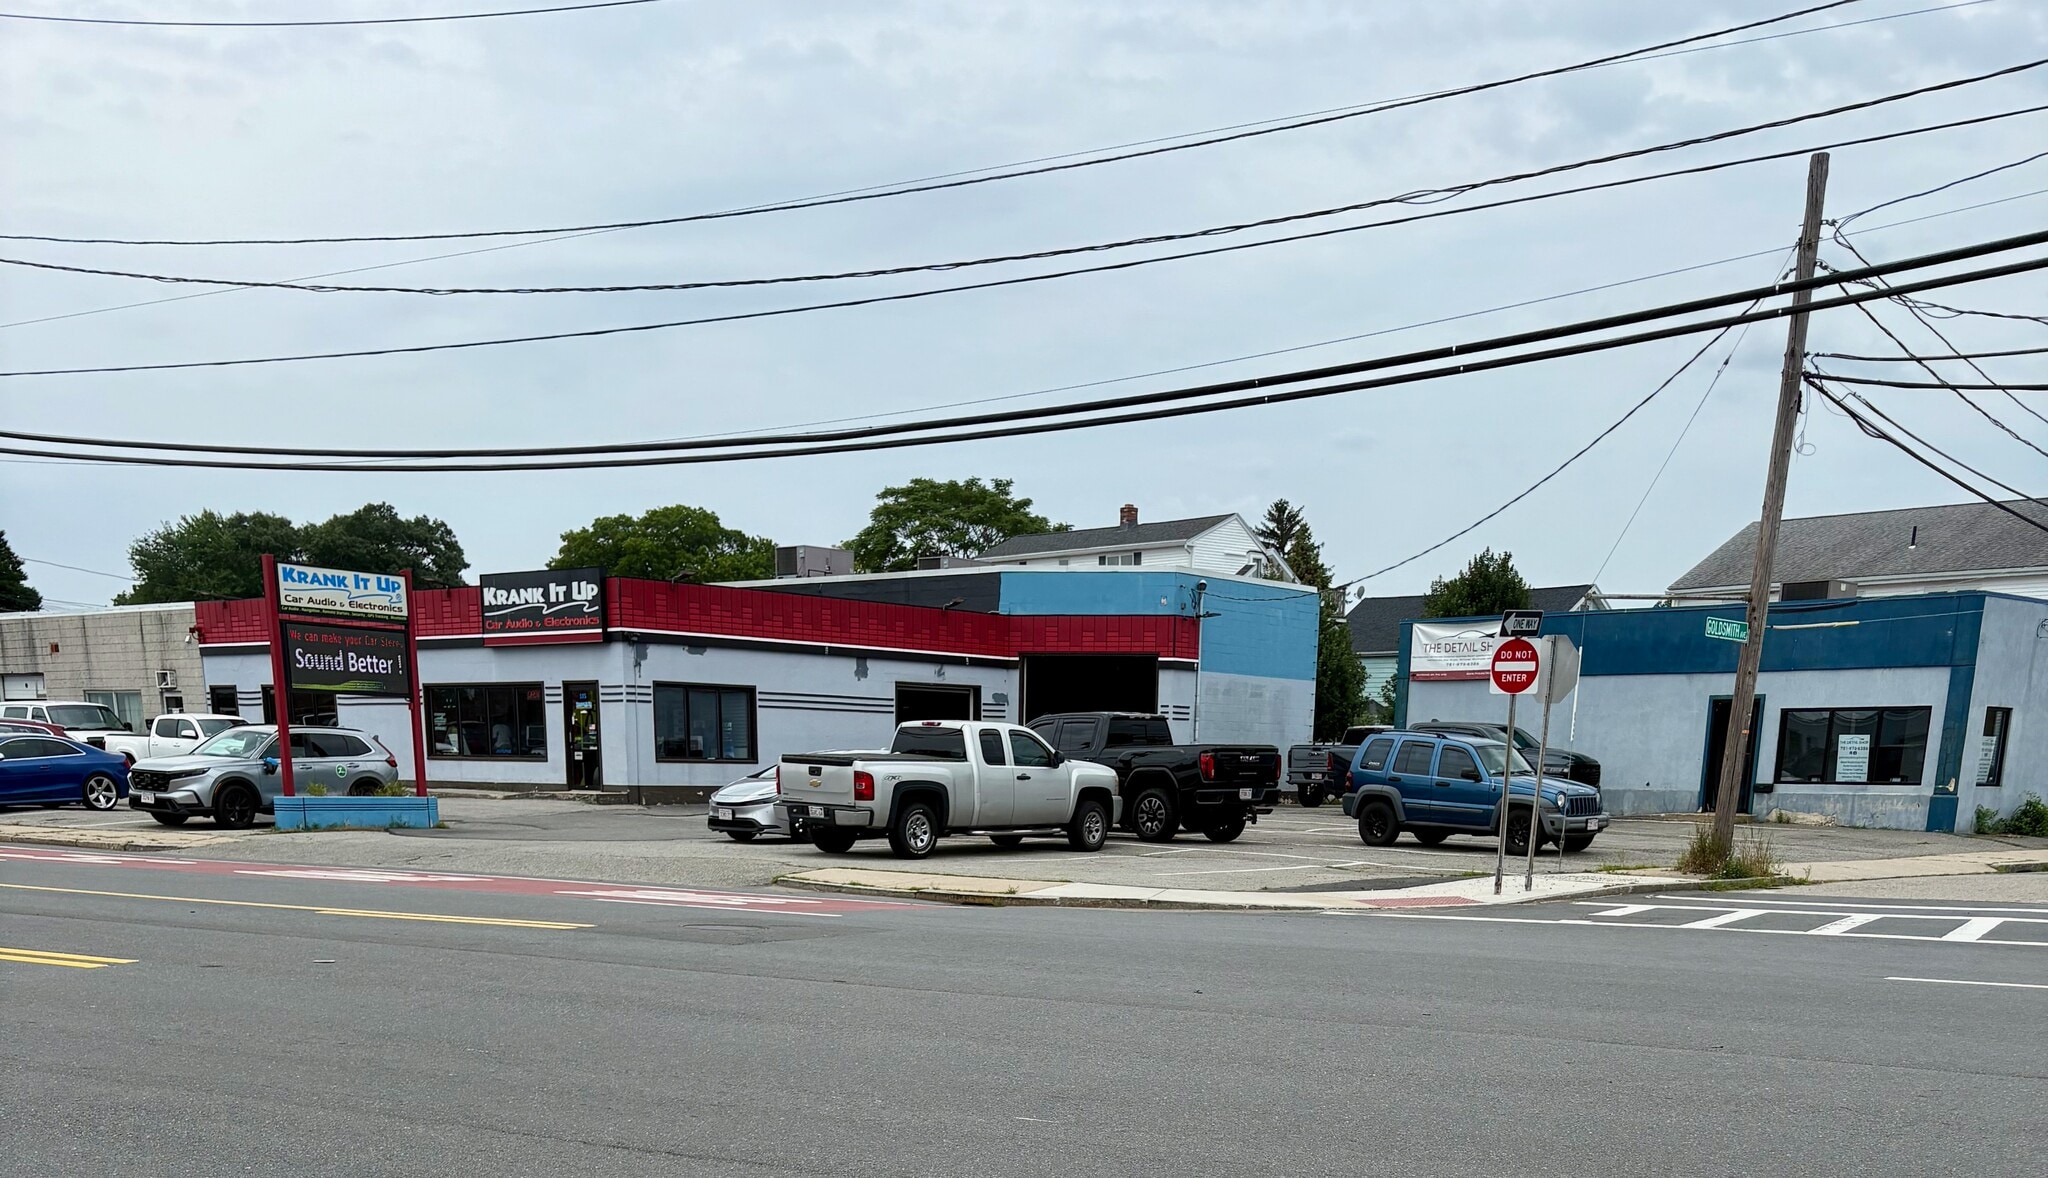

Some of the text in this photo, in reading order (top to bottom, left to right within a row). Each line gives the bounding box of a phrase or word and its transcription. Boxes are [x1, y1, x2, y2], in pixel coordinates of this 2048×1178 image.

[281, 566, 349, 589] KRANK
[284, 594, 303, 604] Car
[307, 596, 337, 607] Audio
[348, 600, 403, 613] Electronics
[483, 586, 546, 606] KRANK
[485, 620, 502, 630] Car
[505, 618, 533, 629] Audio
[544, 615, 600, 627] Electronics
[1512, 619, 1538, 629] ONE WAY
[1708, 620, 1740, 637] GOLDSMITH
[304, 632, 319, 642] can
[321, 633, 342, 644] make
[345, 636, 362, 647] your
[1423, 641, 1493, 654] THE DETAIL SH
[1501, 650, 1513, 660] DO
[1515, 650, 1533, 659] NOT
[295, 648, 403, 675] Sound Better !
[1501, 673, 1527, 683] ENTER
